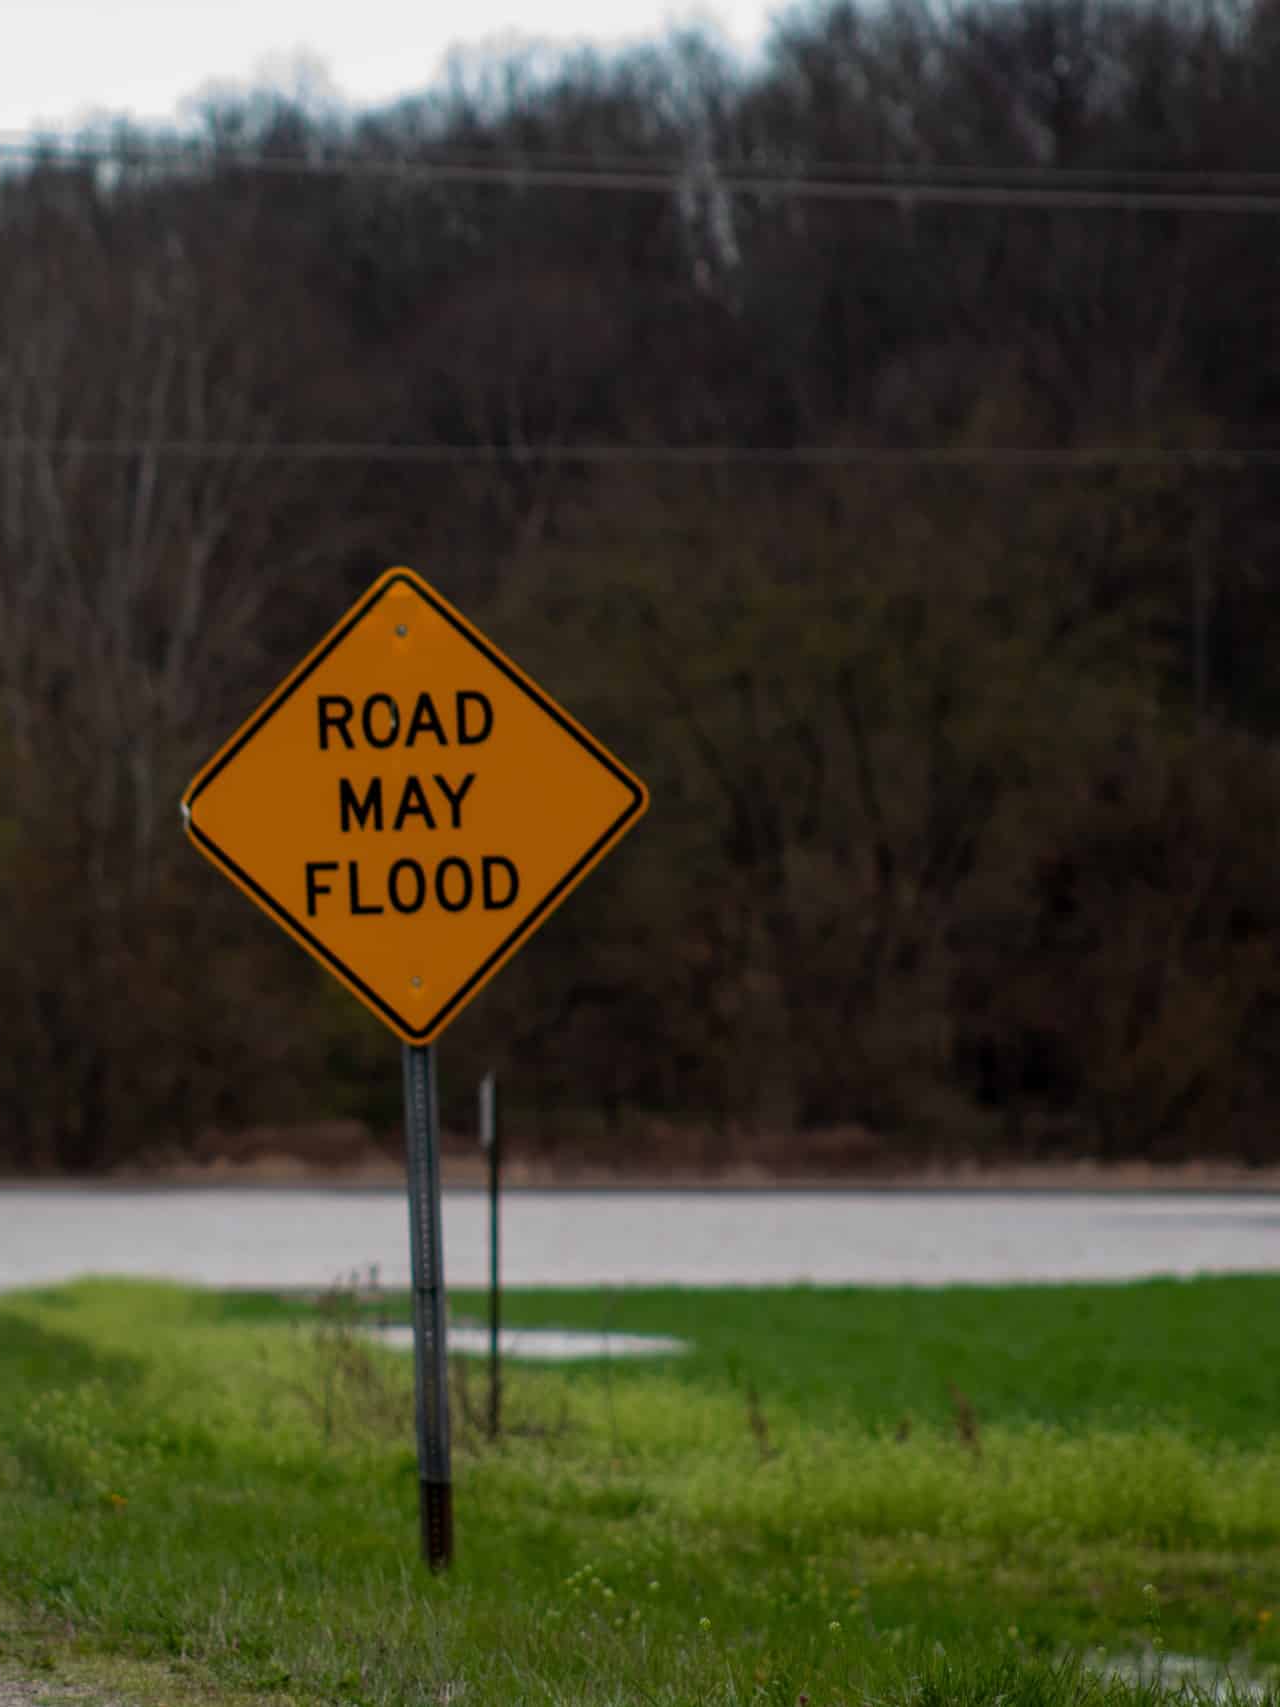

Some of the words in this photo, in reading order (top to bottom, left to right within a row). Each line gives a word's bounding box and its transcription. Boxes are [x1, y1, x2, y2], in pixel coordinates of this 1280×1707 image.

[316, 690, 494, 751] ROAD
[338, 772, 476, 833] MAY
[305, 855, 520, 918] FLOOD
